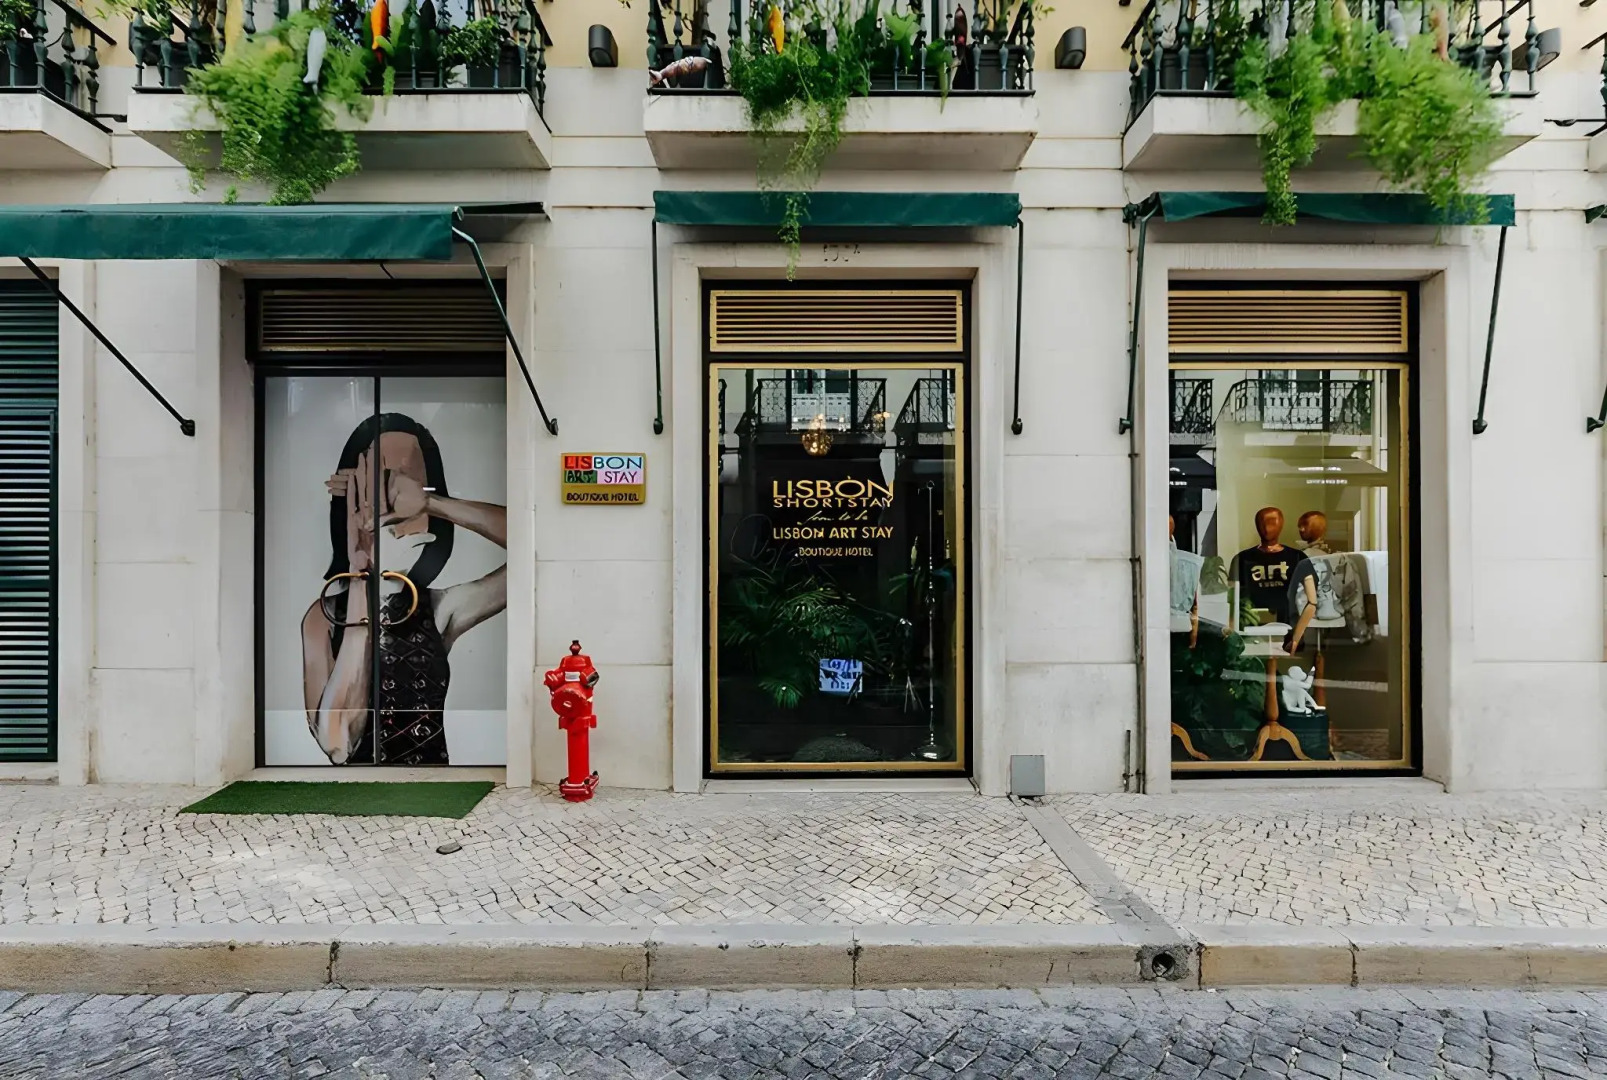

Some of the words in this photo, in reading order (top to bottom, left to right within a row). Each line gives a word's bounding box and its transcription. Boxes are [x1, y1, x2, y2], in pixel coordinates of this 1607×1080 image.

[564, 455, 642, 470] LISBON
[566, 470, 594, 483] ART
[604, 471, 637, 484] STAY
[773, 479, 894, 498] LISBON
[566, 492, 609, 502] BOUTIQUE
[611, 493, 639, 502] HOTEL
[773, 527, 825, 539] LISBON
[829, 526, 858, 539] ART
[862, 526, 894, 539] STAY
[798, 546, 843, 557] BOUTIQUE
[845, 547, 874, 557] HOTEL
[1250, 561, 1289, 581] art
